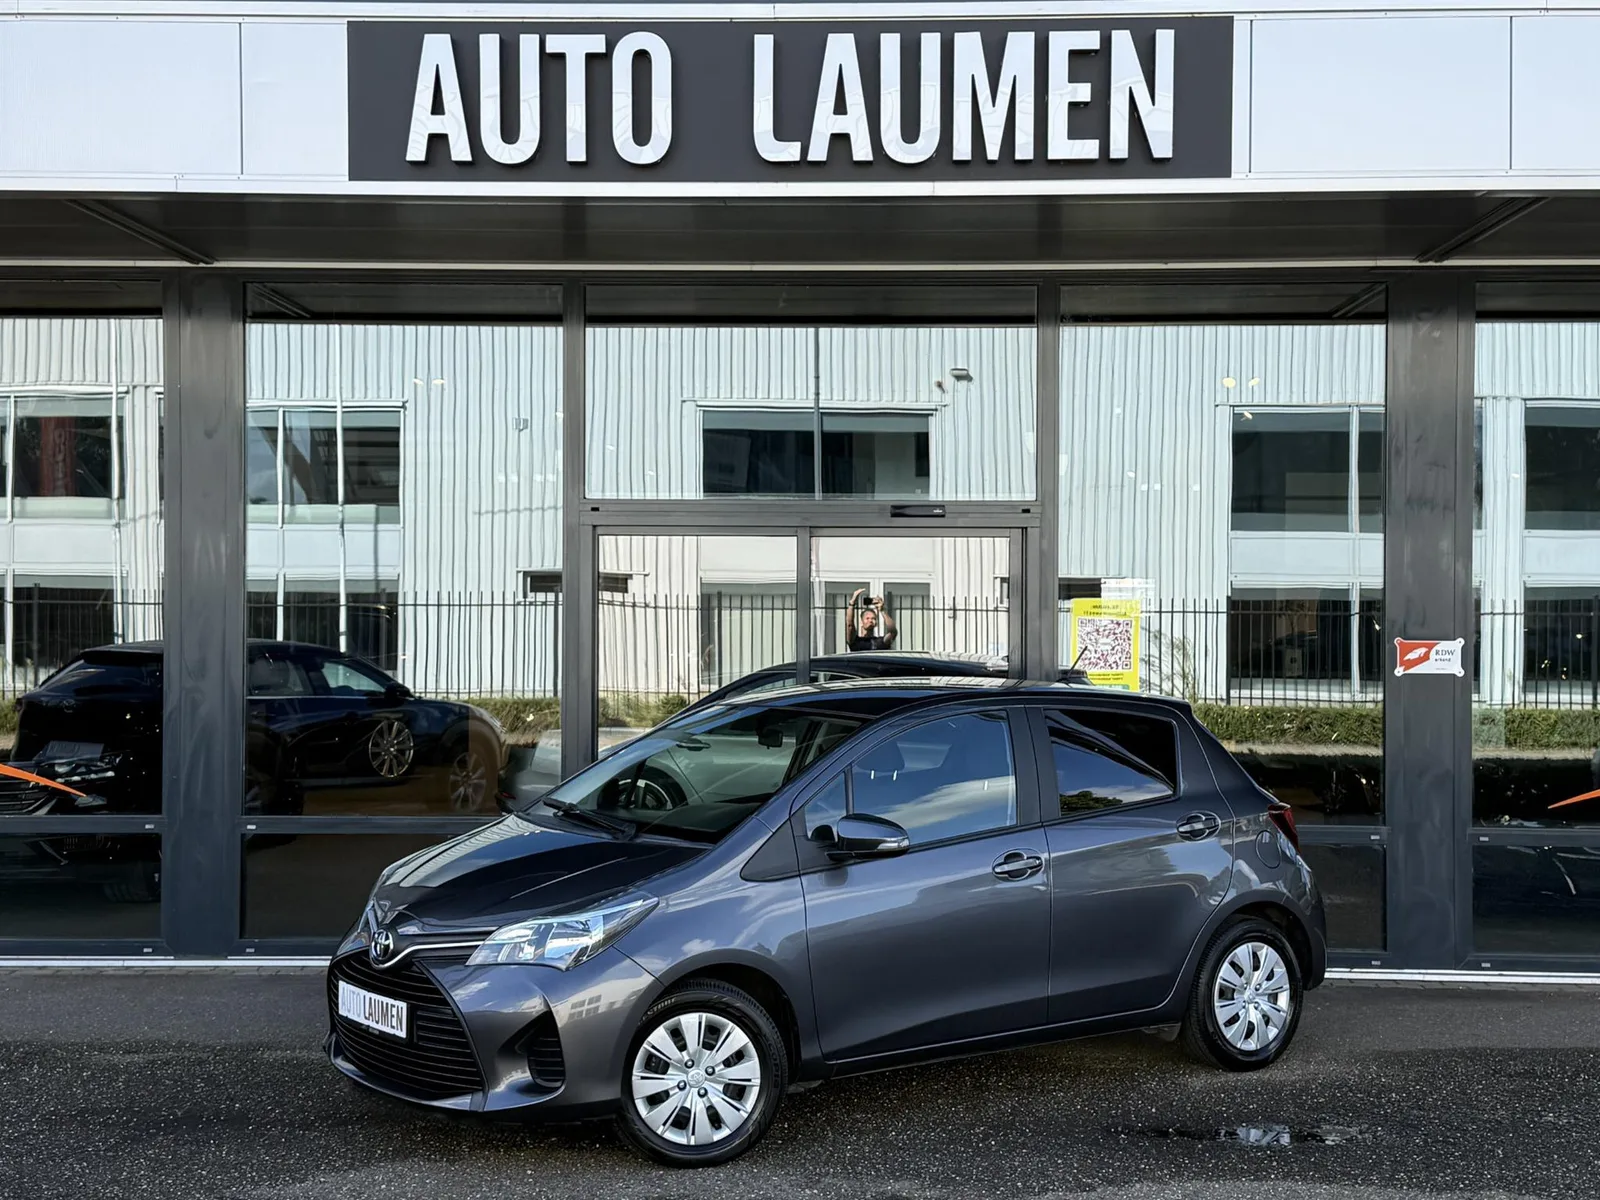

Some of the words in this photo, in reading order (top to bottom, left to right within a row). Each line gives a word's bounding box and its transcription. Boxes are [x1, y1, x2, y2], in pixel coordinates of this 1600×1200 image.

[405, 31, 673, 165] AUTO
[753, 29, 1175, 164] LAUMEN
[341, 986, 361, 1018] AUTO
[363, 994, 403, 1032] LAUMEN
